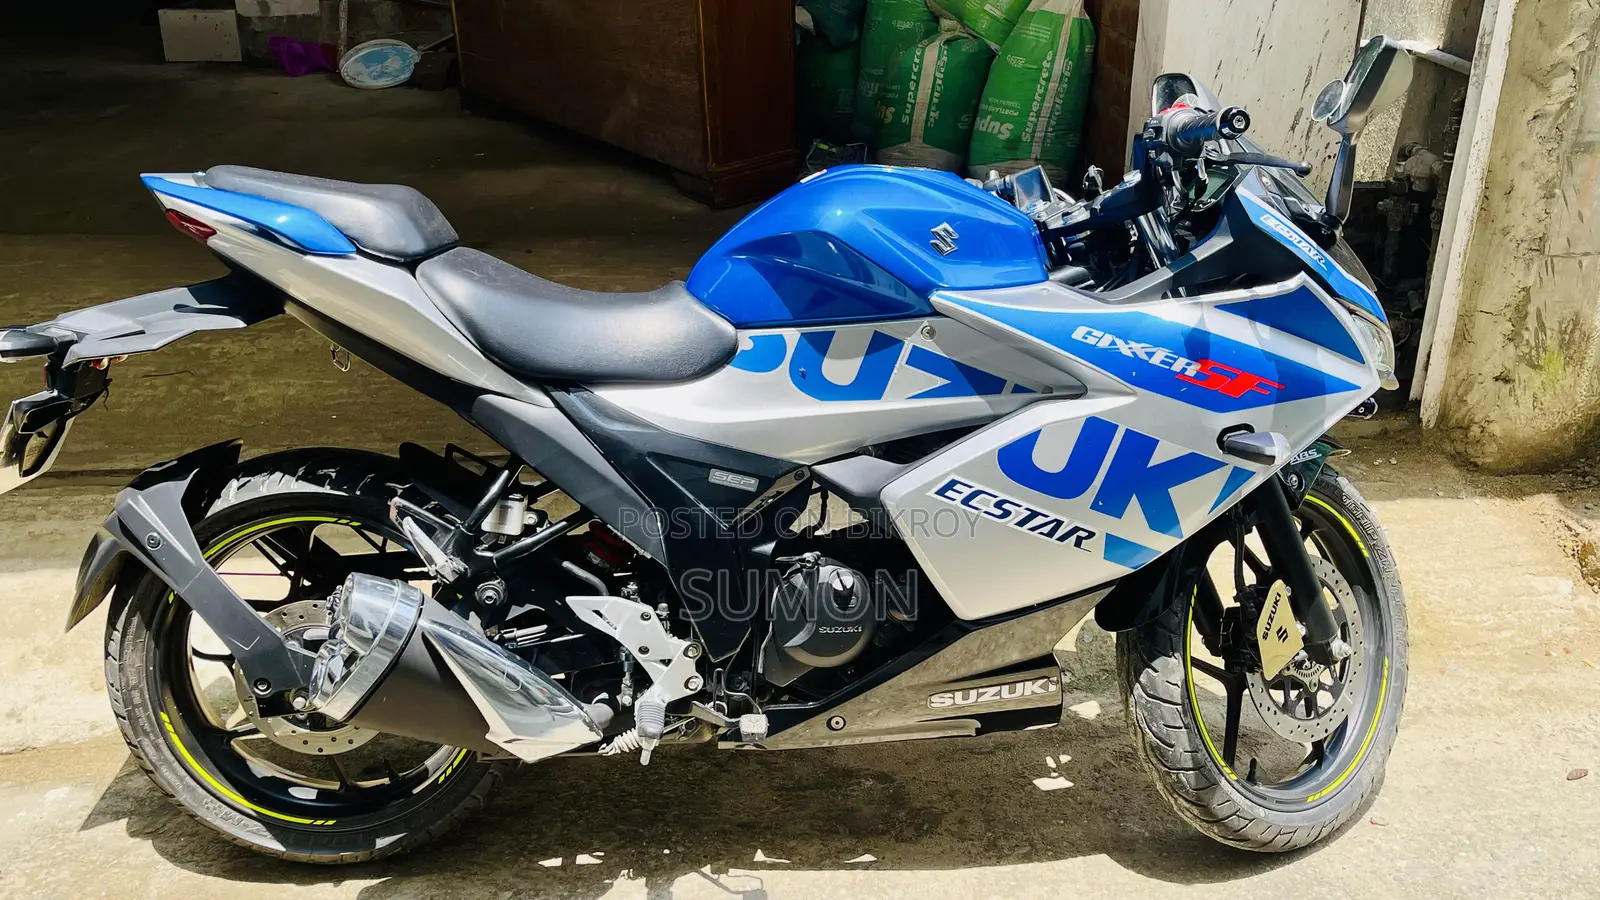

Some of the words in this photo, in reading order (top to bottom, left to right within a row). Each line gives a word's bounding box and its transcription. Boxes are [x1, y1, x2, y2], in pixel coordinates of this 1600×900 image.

[1021, 50, 1053, 142] Supercrete
[1260, 213, 1328, 271] ECSTAR
[1071, 325, 1202, 377] GIXXER
[1175, 358, 1286, 399] SF
[712, 471, 756, 485] SEP
[933, 477, 1097, 553] ECSTAR
[819, 624, 863, 634] SUZUKI
[1262, 591, 1282, 641] SUZUKI
[930, 676, 1058, 708] SUZUKI
